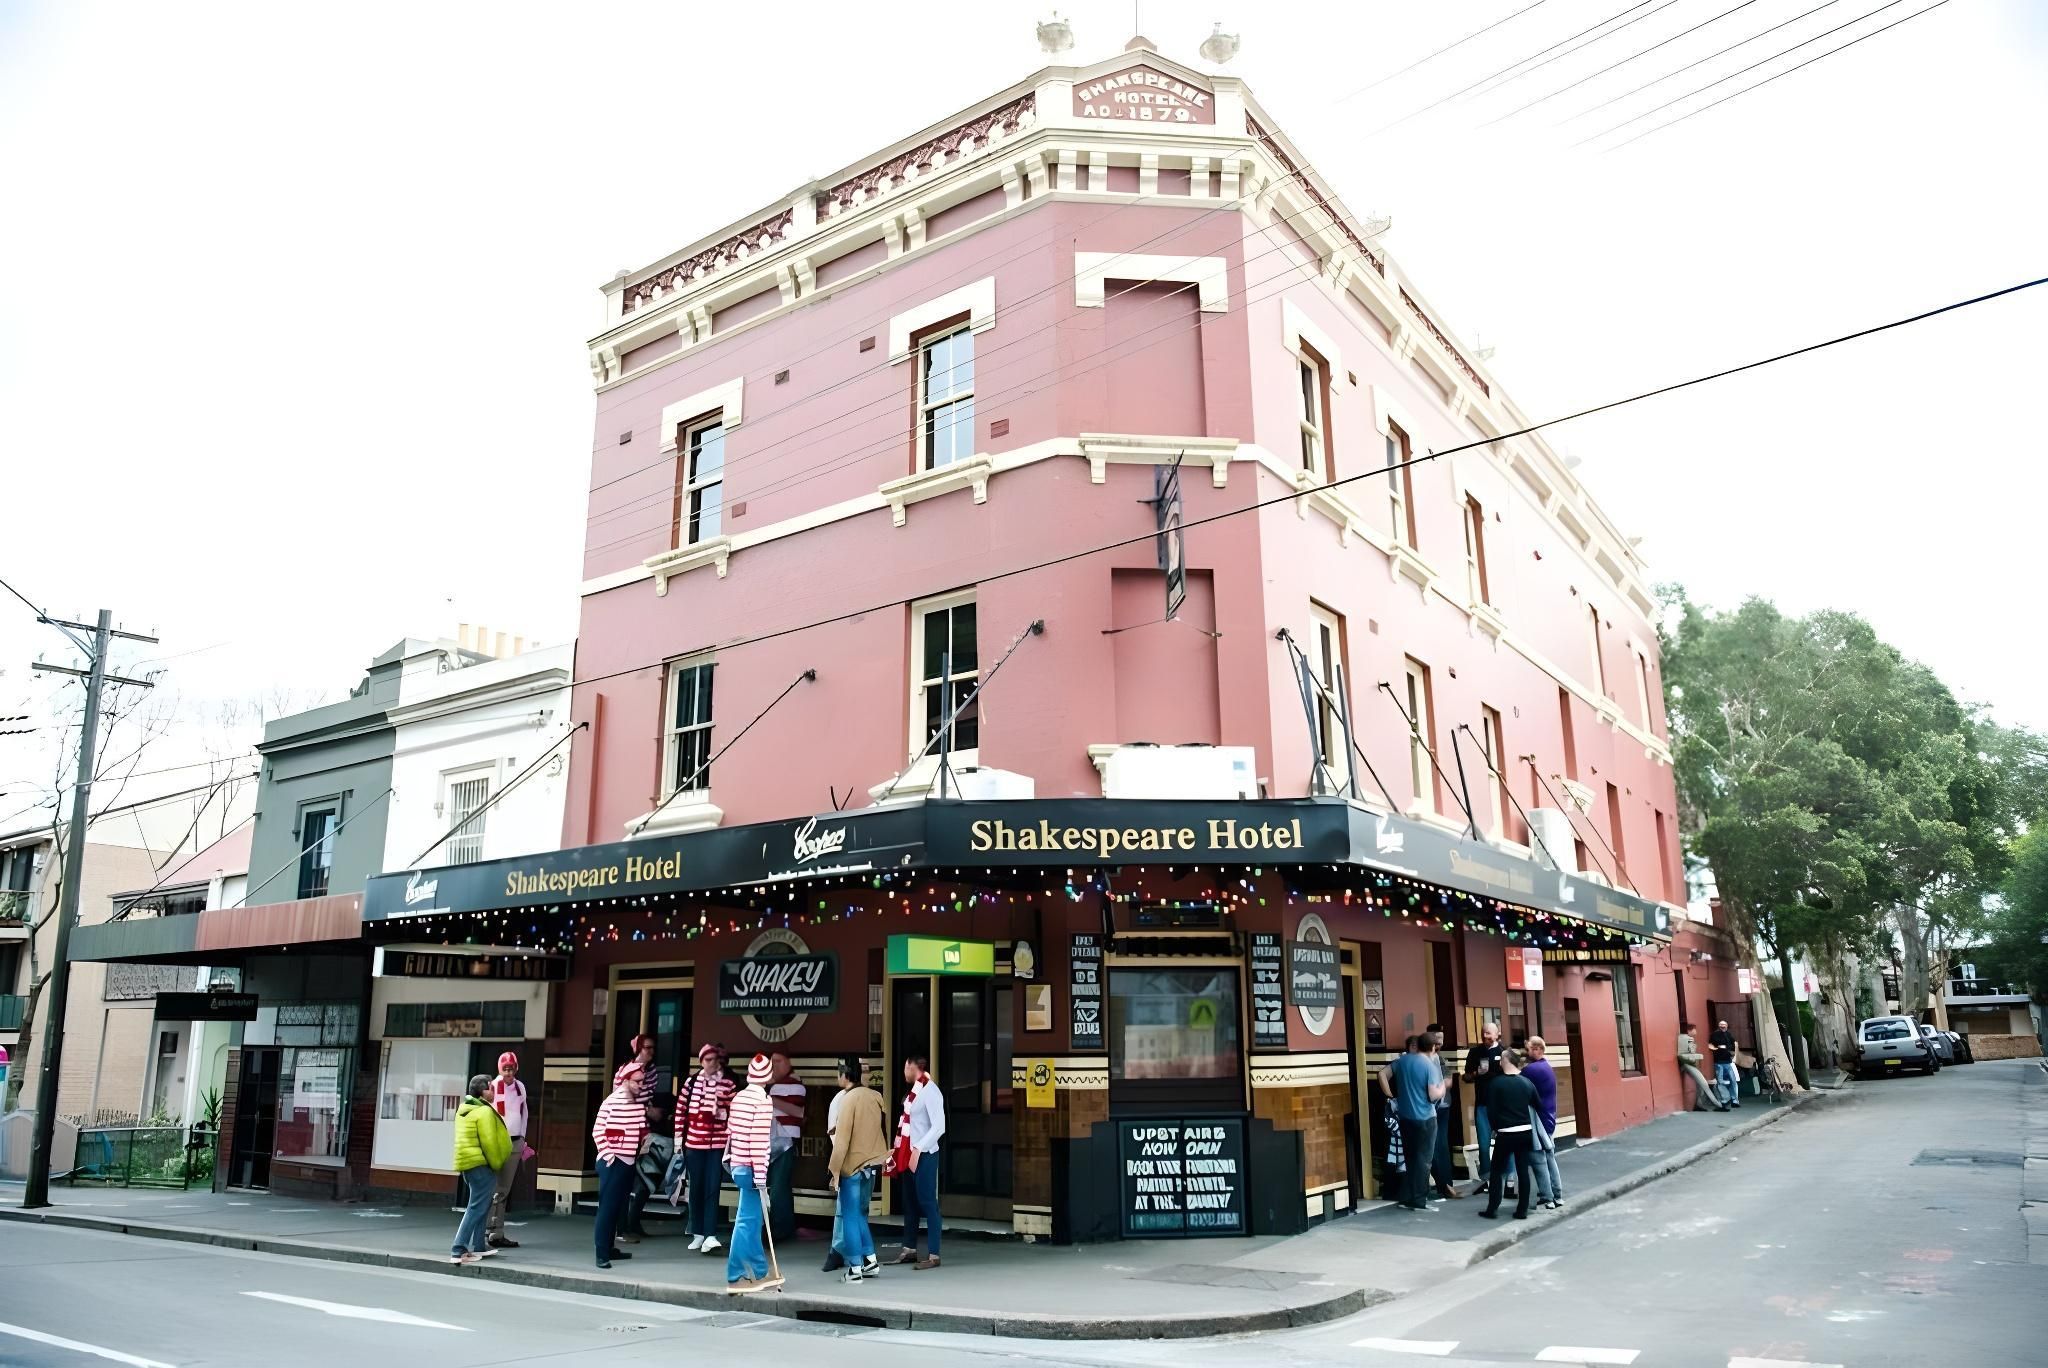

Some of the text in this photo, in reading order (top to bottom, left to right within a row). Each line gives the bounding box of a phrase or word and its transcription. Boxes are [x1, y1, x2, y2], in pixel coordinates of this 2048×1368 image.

[971, 818, 1304, 859] Shakespeare Hotel
[505, 851, 682, 897] Shakespeare Hotel
[733, 961, 825, 997] SHAKEY
[1186, 1141, 1222, 1155] OPEN
